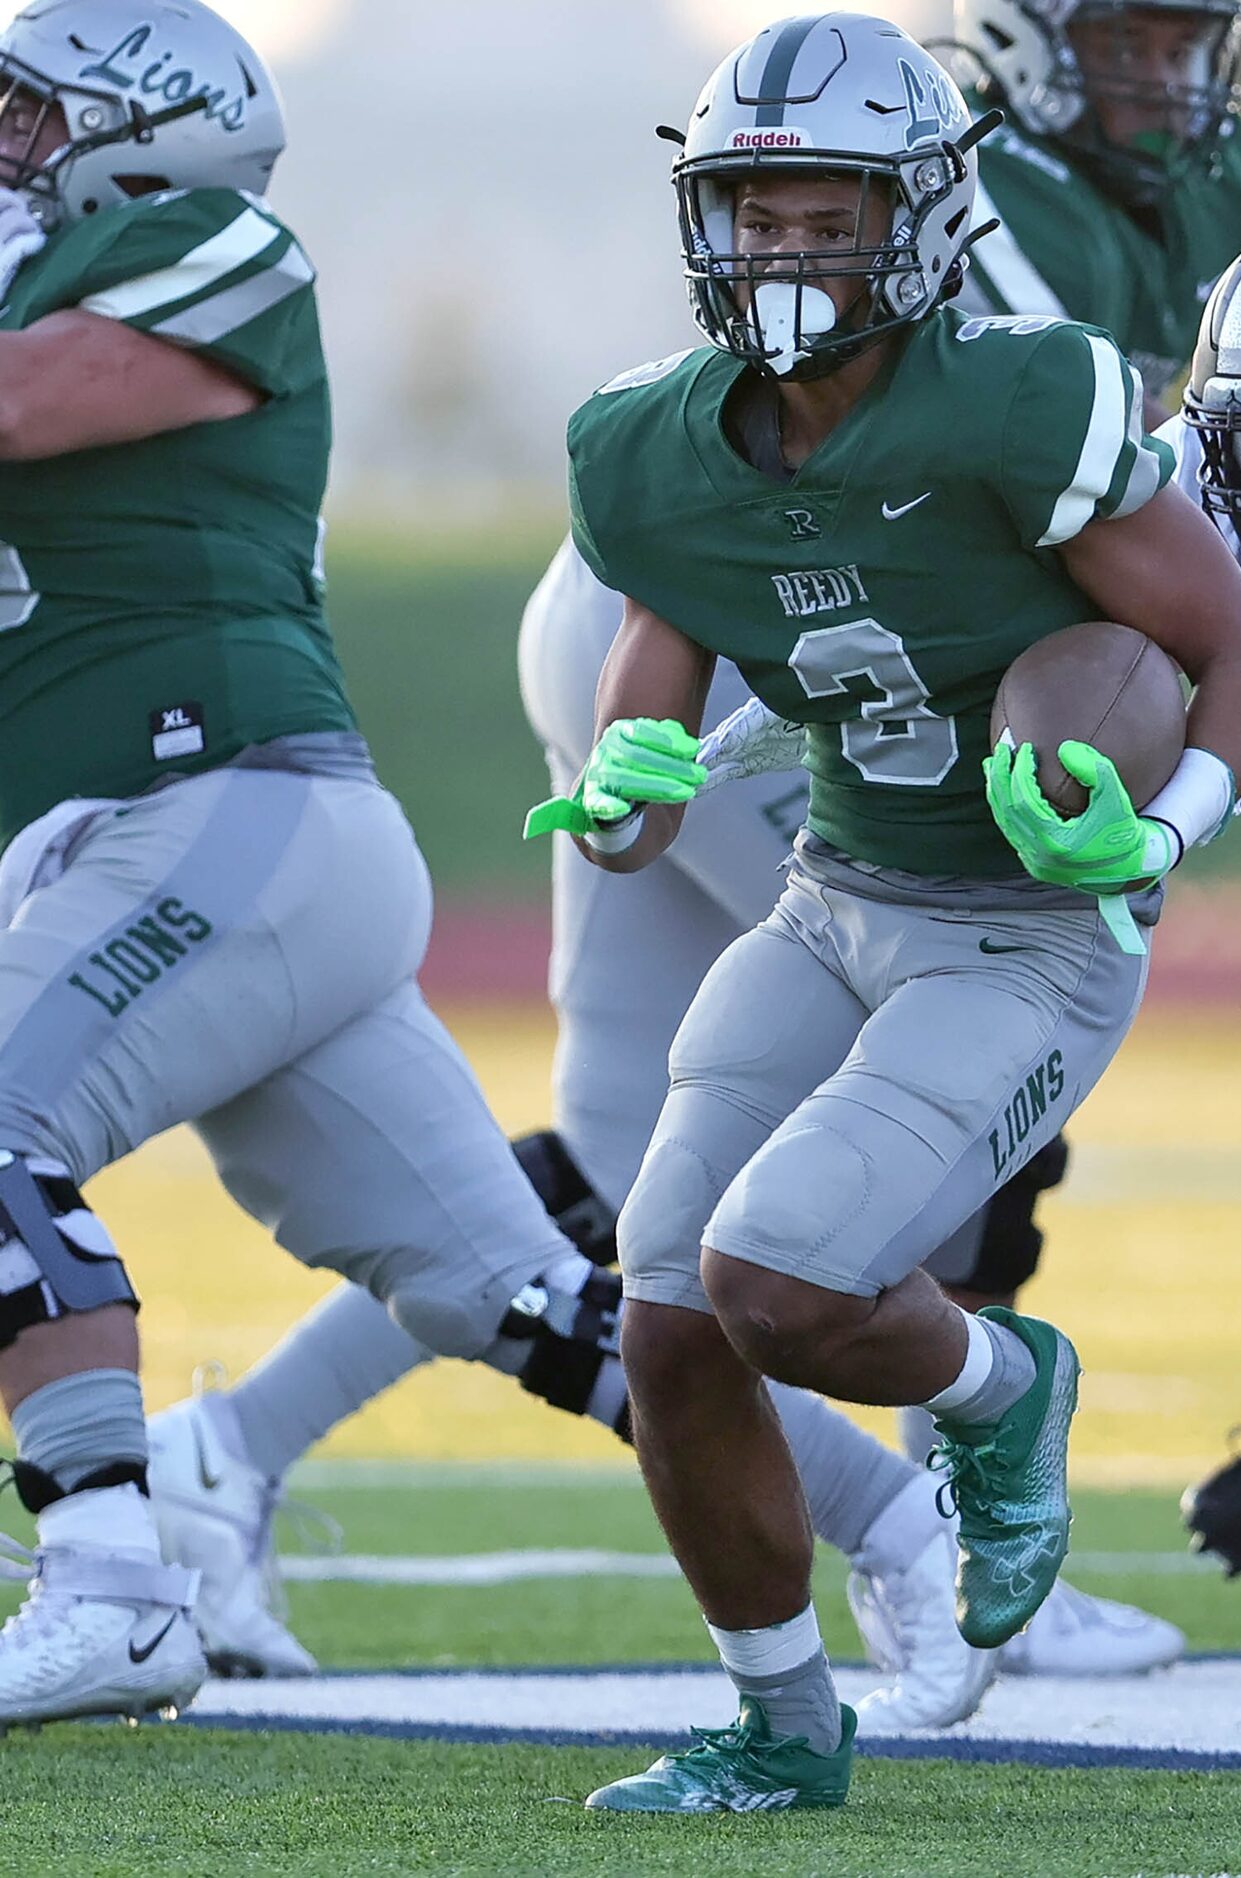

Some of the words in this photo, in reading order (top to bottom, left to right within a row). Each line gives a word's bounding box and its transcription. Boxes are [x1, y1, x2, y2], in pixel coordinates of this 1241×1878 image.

[732, 131, 801, 147] Riddell
[784, 509, 821, 539] R
[771, 564, 869, 617] REEDY
[162, 708, 192, 731] XL
[787, 617, 960, 787] 3
[67, 896, 212, 1018] LIONS
[988, 1049, 1065, 1183] LIONS
